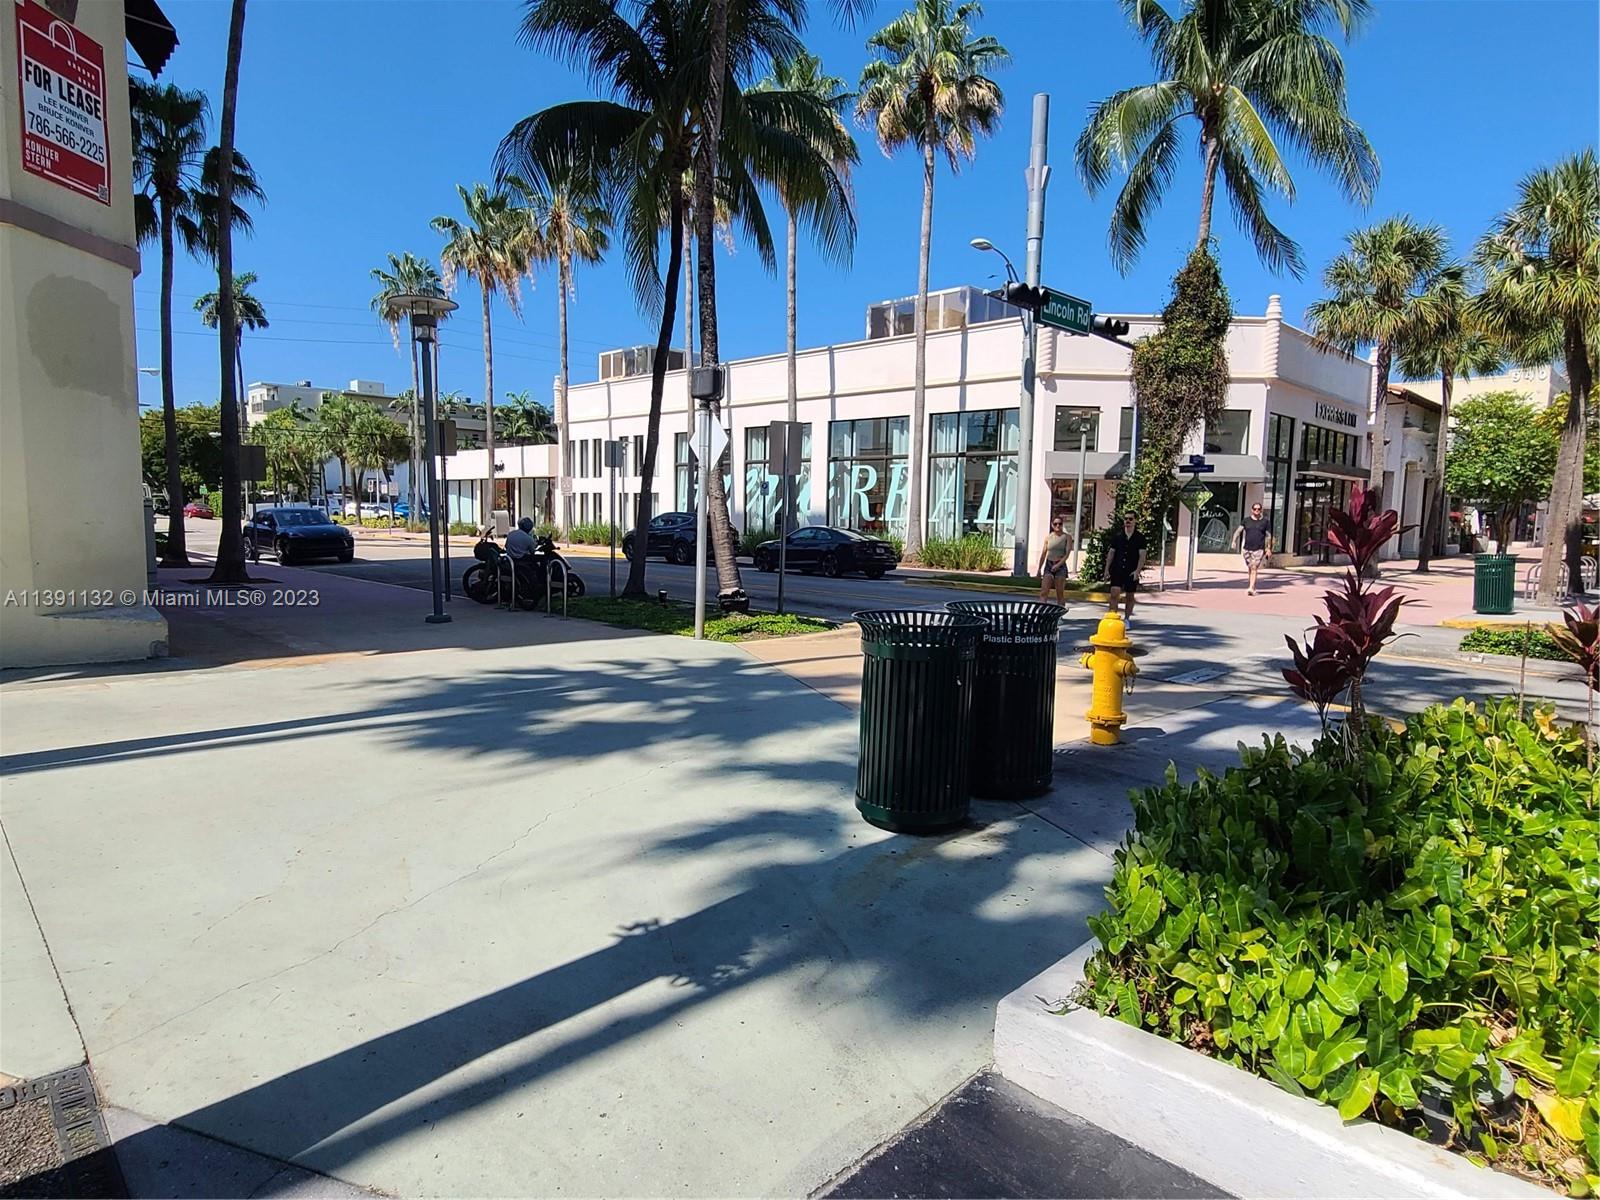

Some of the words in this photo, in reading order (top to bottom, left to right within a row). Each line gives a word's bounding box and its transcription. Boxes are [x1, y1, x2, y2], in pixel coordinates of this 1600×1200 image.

[24, 58, 53, 94] FOR
[57, 76, 102, 121] LEASE
[38, 102, 64, 122] BRUCE
[43, 95, 58, 109] LEE
[27, 110, 105, 163] 786-566-2225
[25, 137, 60, 162] KONIVER
[25, 149, 52, 170] STERN
[1077, 306, 1089, 326] Rd
[1512, 368, 1548, 382] 940
[983, 634, 1013, 643] Plastic
[1014, 635, 1042, 644] Bottles
